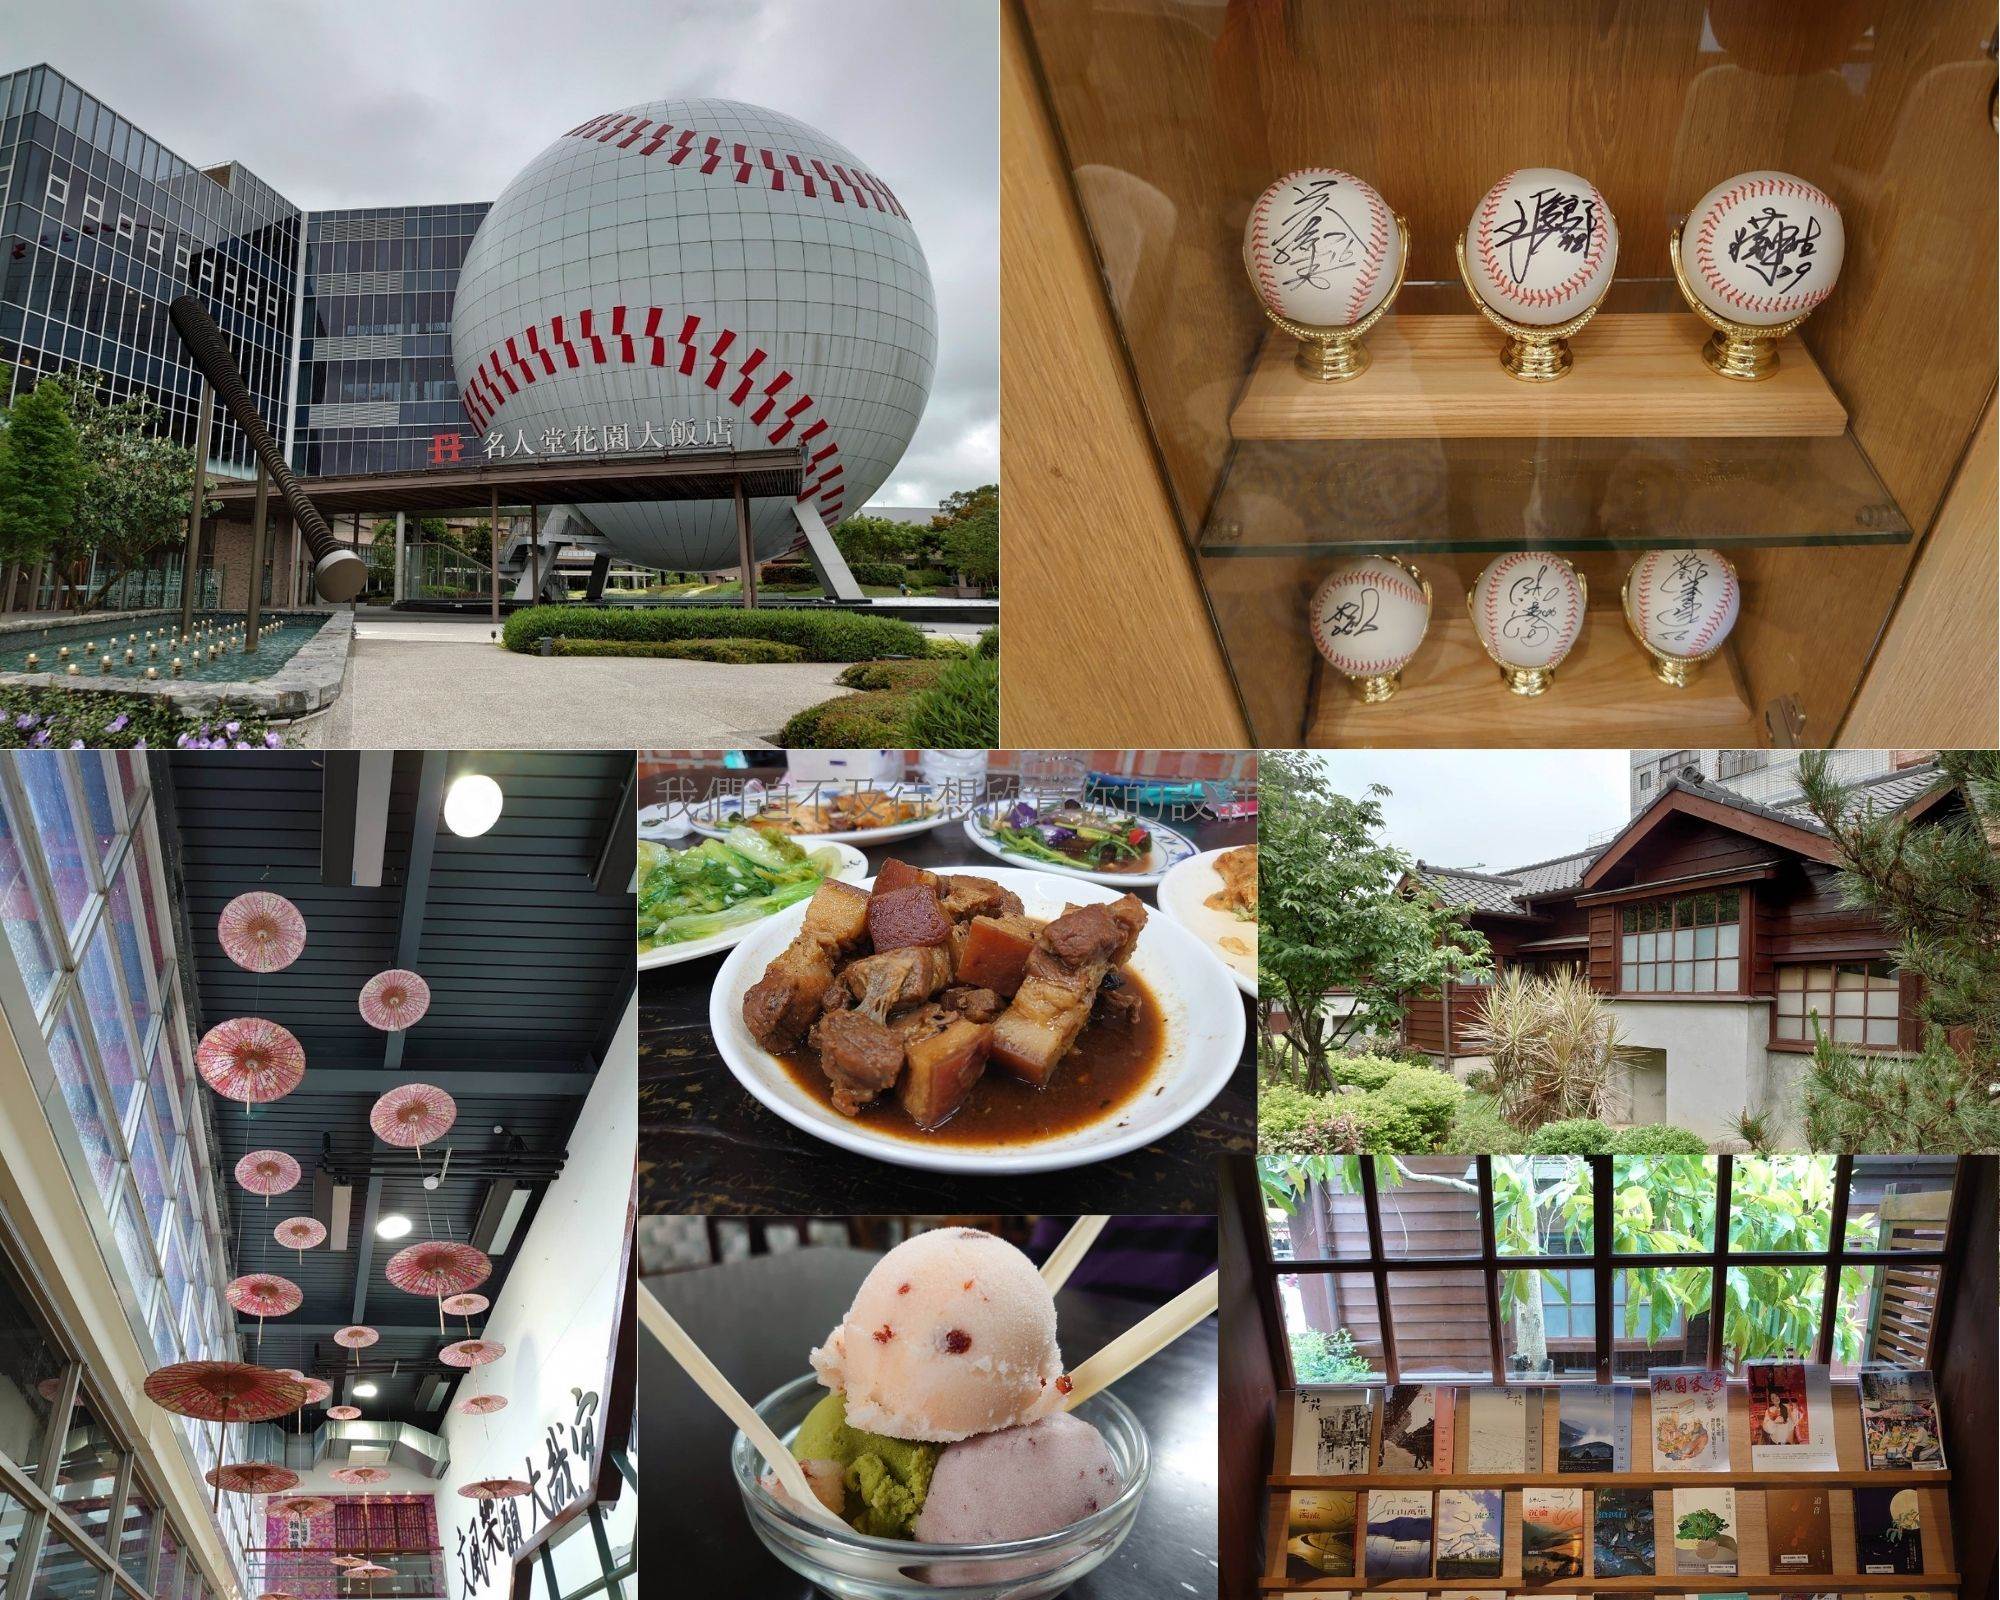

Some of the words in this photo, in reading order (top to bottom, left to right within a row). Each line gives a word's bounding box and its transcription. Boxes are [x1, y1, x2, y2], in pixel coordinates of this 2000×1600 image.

[482, 415, 735, 459] 名人堂花園大飯店
